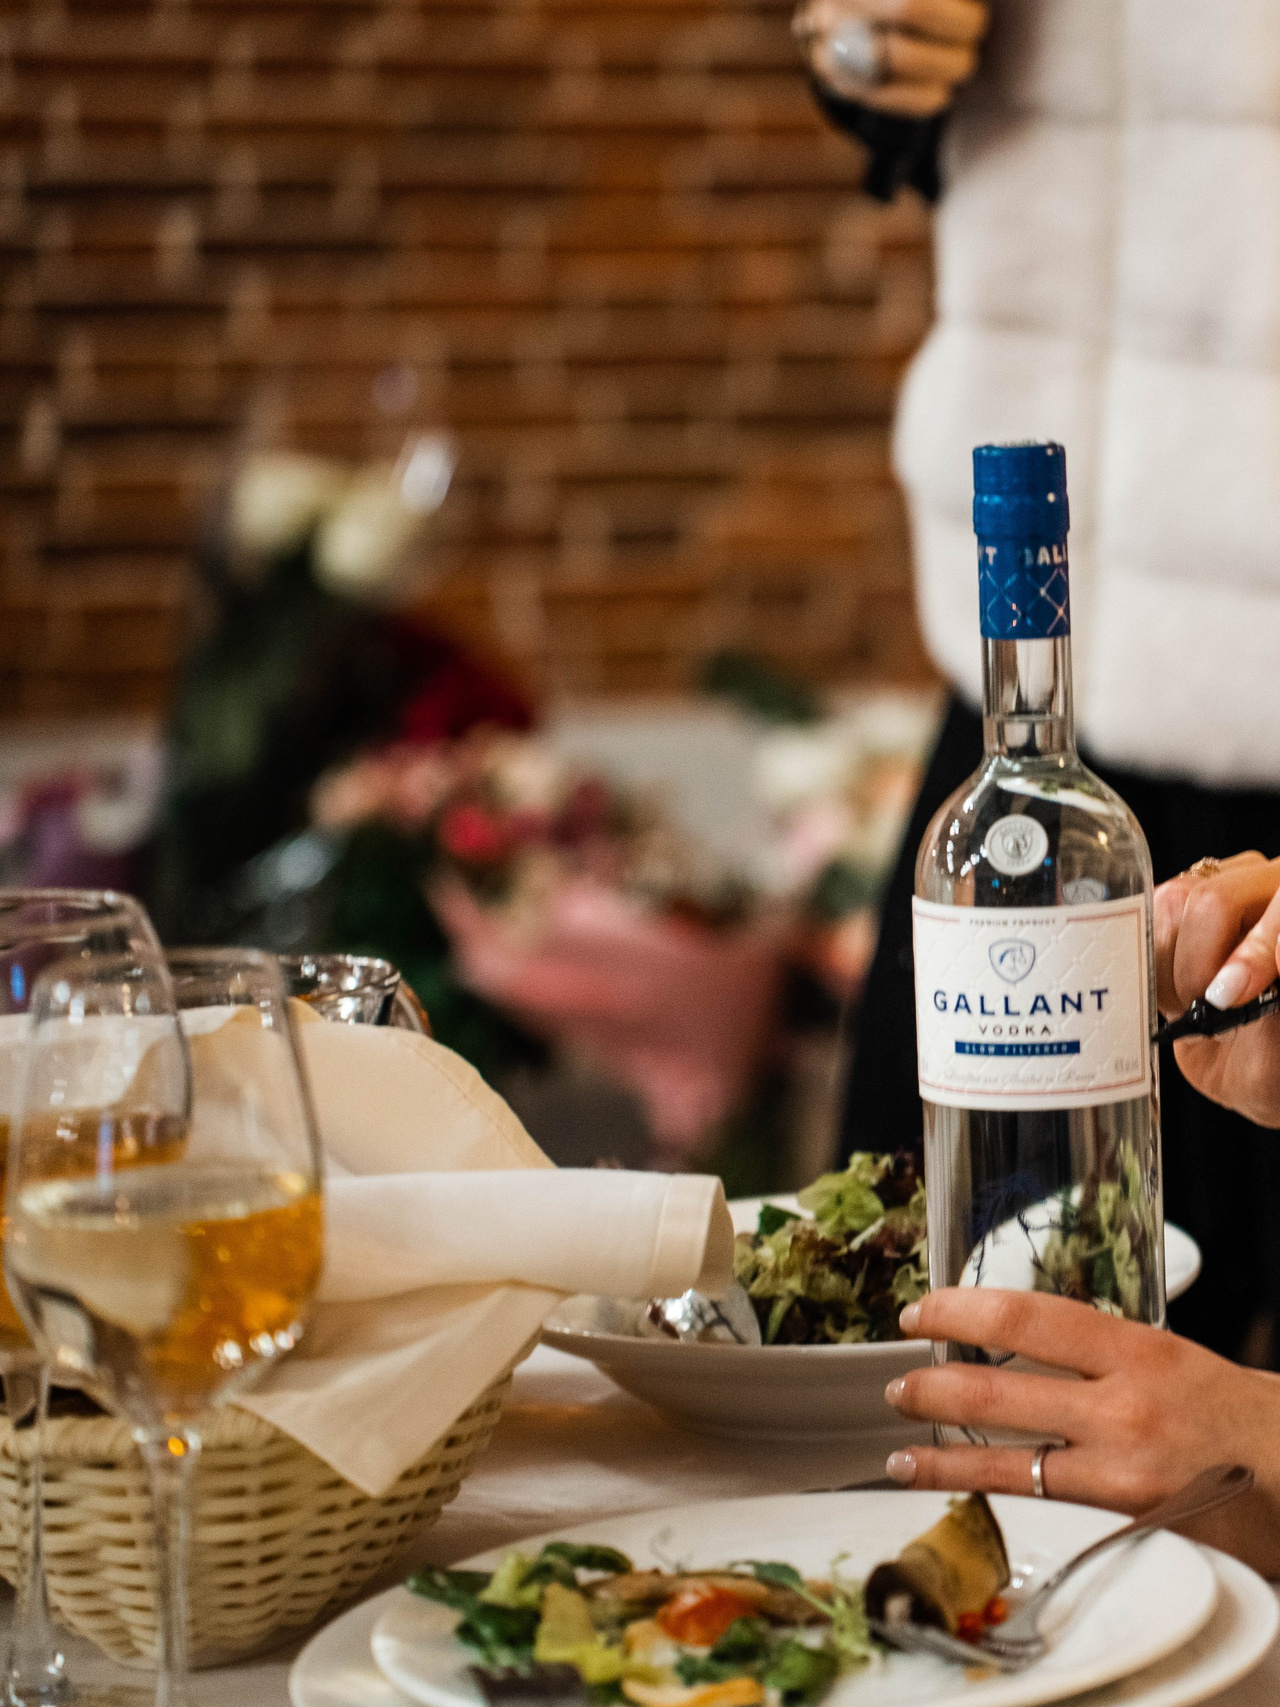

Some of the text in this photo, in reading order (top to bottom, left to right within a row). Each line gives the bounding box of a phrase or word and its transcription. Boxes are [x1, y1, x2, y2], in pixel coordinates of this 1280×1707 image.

[933, 989, 1109, 1016] GALLANT
[979, 1024, 1052, 1036] VODKA
[964, 1043, 1068, 1056] SLOW FILTERED
